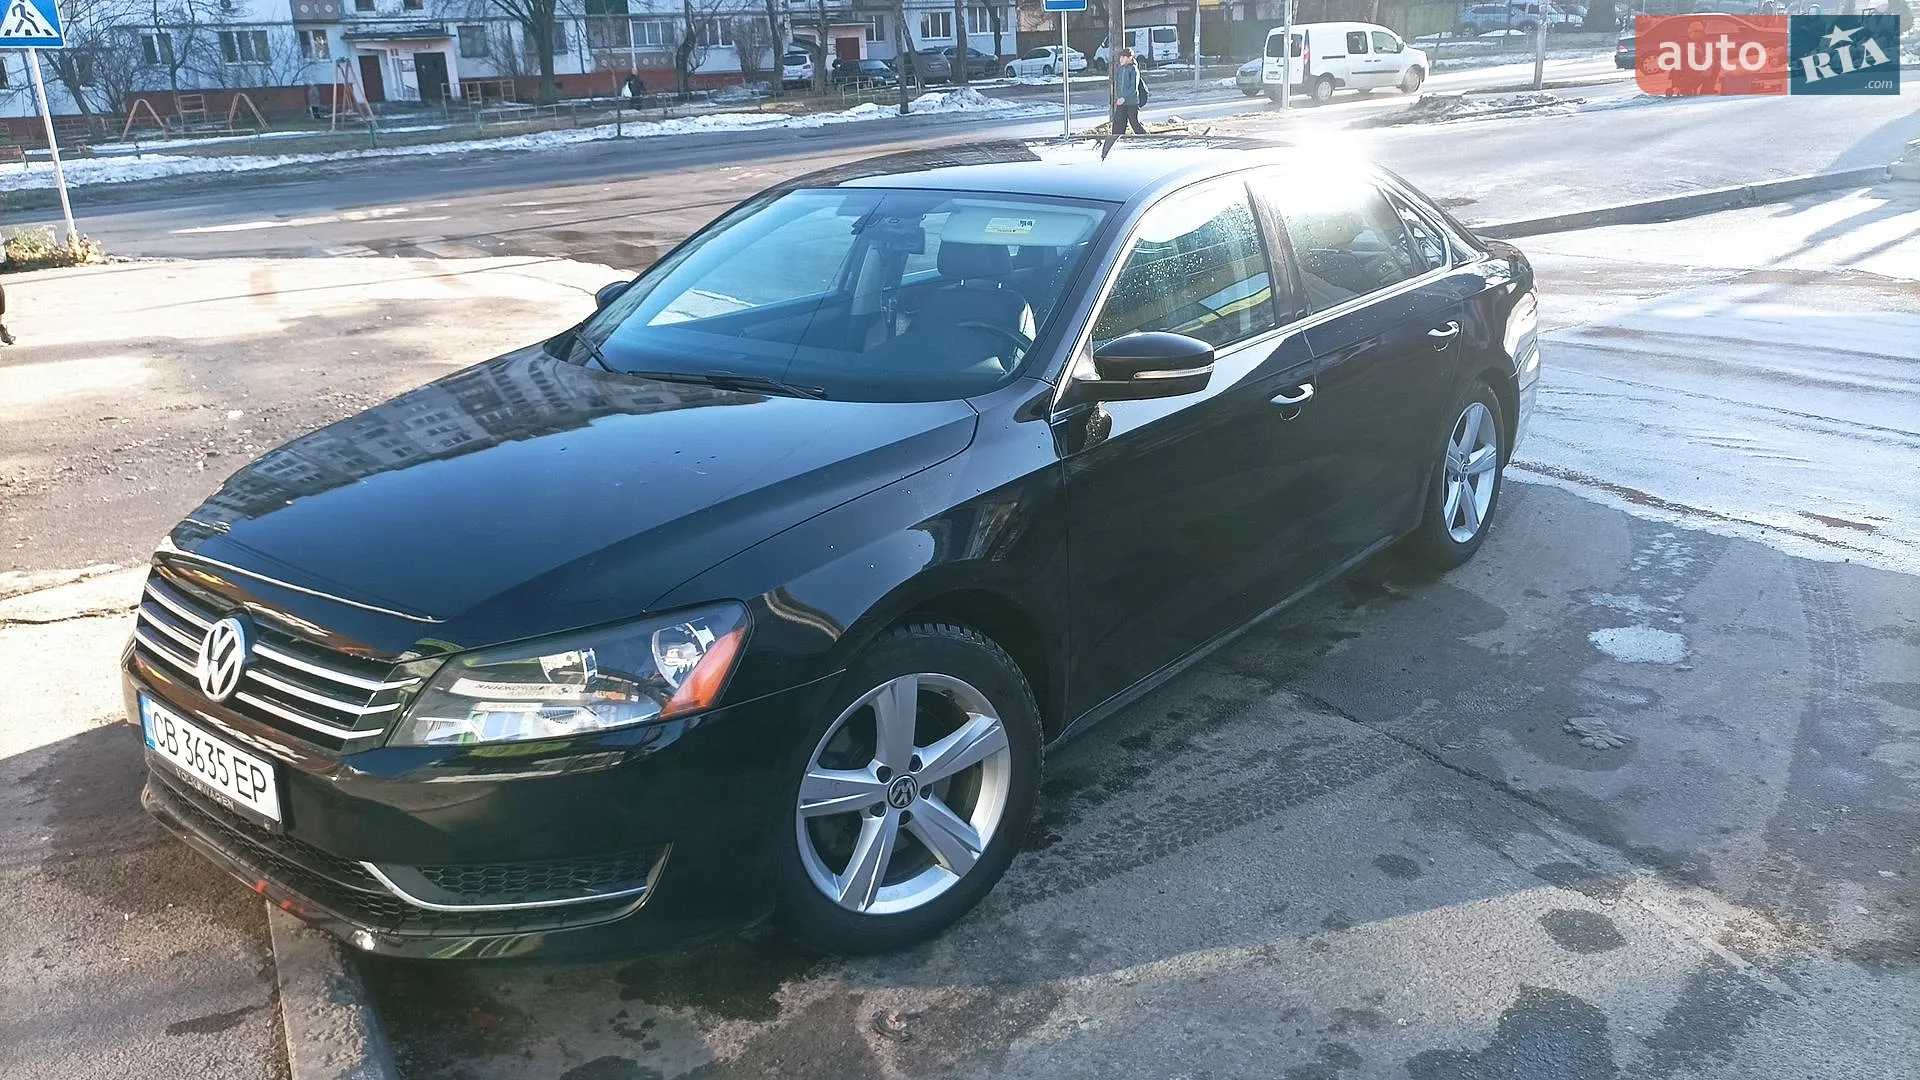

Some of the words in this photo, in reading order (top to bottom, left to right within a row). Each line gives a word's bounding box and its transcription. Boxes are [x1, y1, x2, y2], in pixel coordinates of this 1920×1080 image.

[153, 711, 179, 756] CB
[182, 728, 230, 787] 3635
[233, 755, 267, 803] EP
